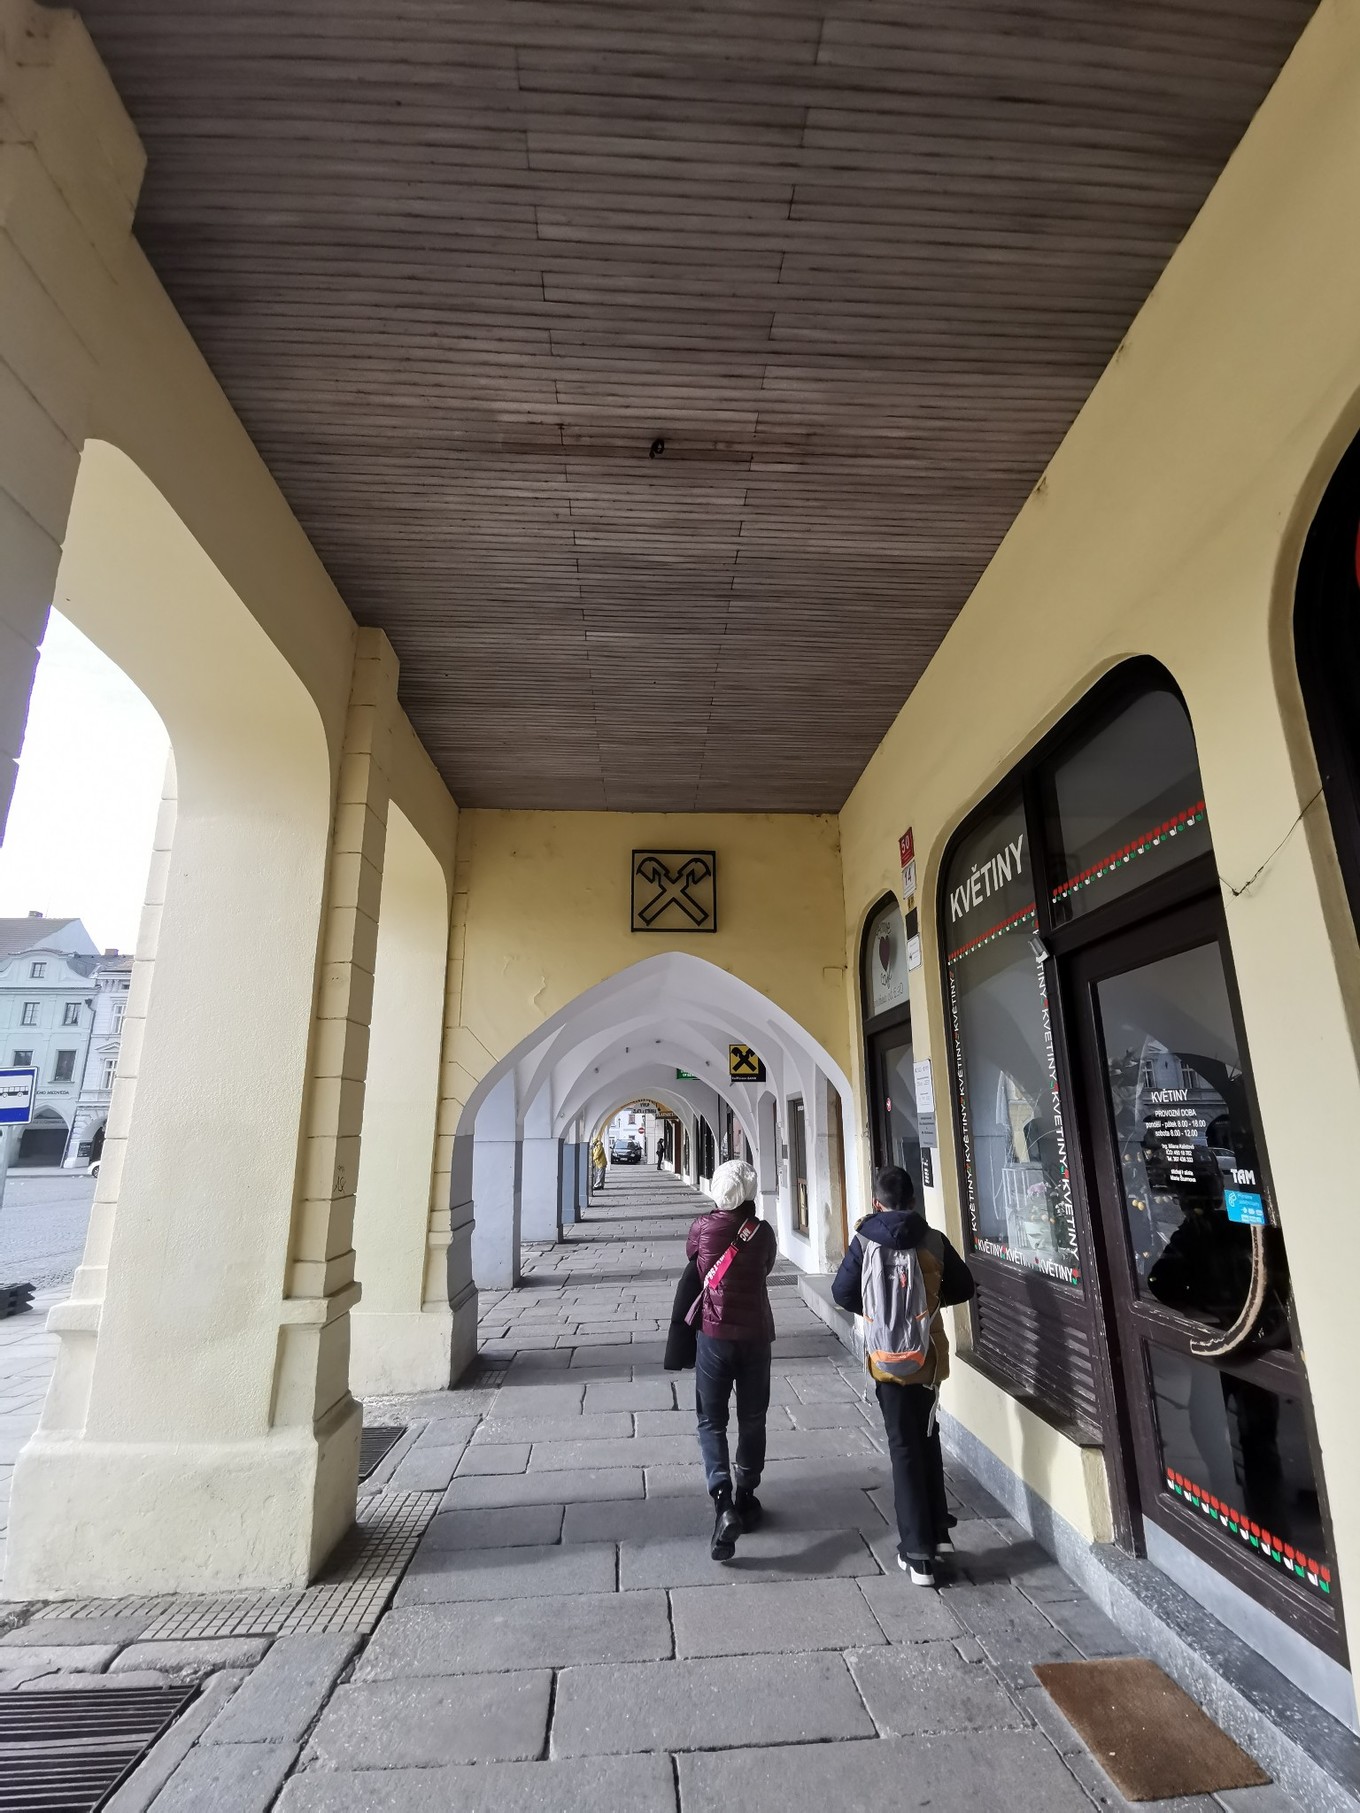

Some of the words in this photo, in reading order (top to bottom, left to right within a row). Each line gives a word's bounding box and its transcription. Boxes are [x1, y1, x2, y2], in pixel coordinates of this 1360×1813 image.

[901, 835, 910, 854] 50
[904, 867, 912, 886] 14
[950, 834, 1023, 923] KVĚTINY
[1151, 1088, 1188, 1103] KVĚTINY
[1181, 1109, 1197, 1117] DOBA
[1230, 1168, 1256, 1185] TAM
[977, 1238, 1003, 1260] KVĚTINY
[1039, 1258, 1073, 1283] KVĚTINY
